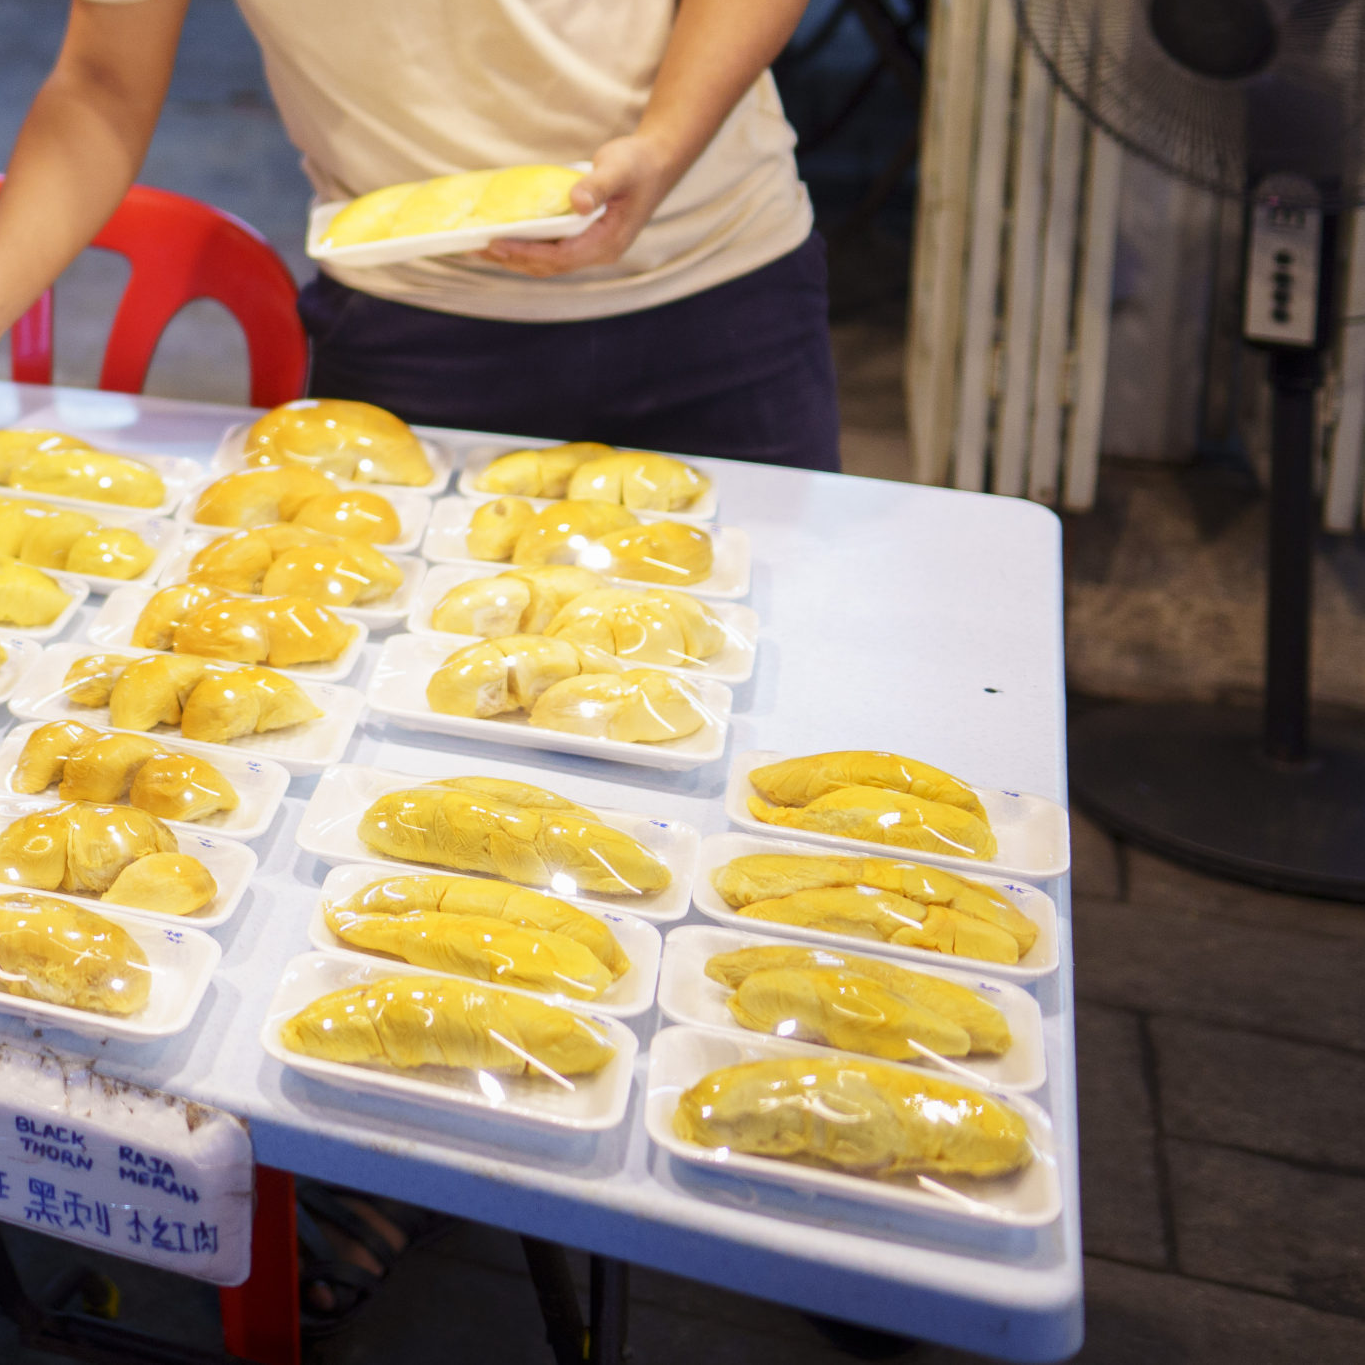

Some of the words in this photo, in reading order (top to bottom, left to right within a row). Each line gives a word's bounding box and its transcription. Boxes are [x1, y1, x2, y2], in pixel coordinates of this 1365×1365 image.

[15, 1115, 86, 1147] BLACK
[119, 1145, 176, 1178] RAJA
[20, 1137, 94, 1171] THORN
[119, 1167, 200, 1204] MERAH
